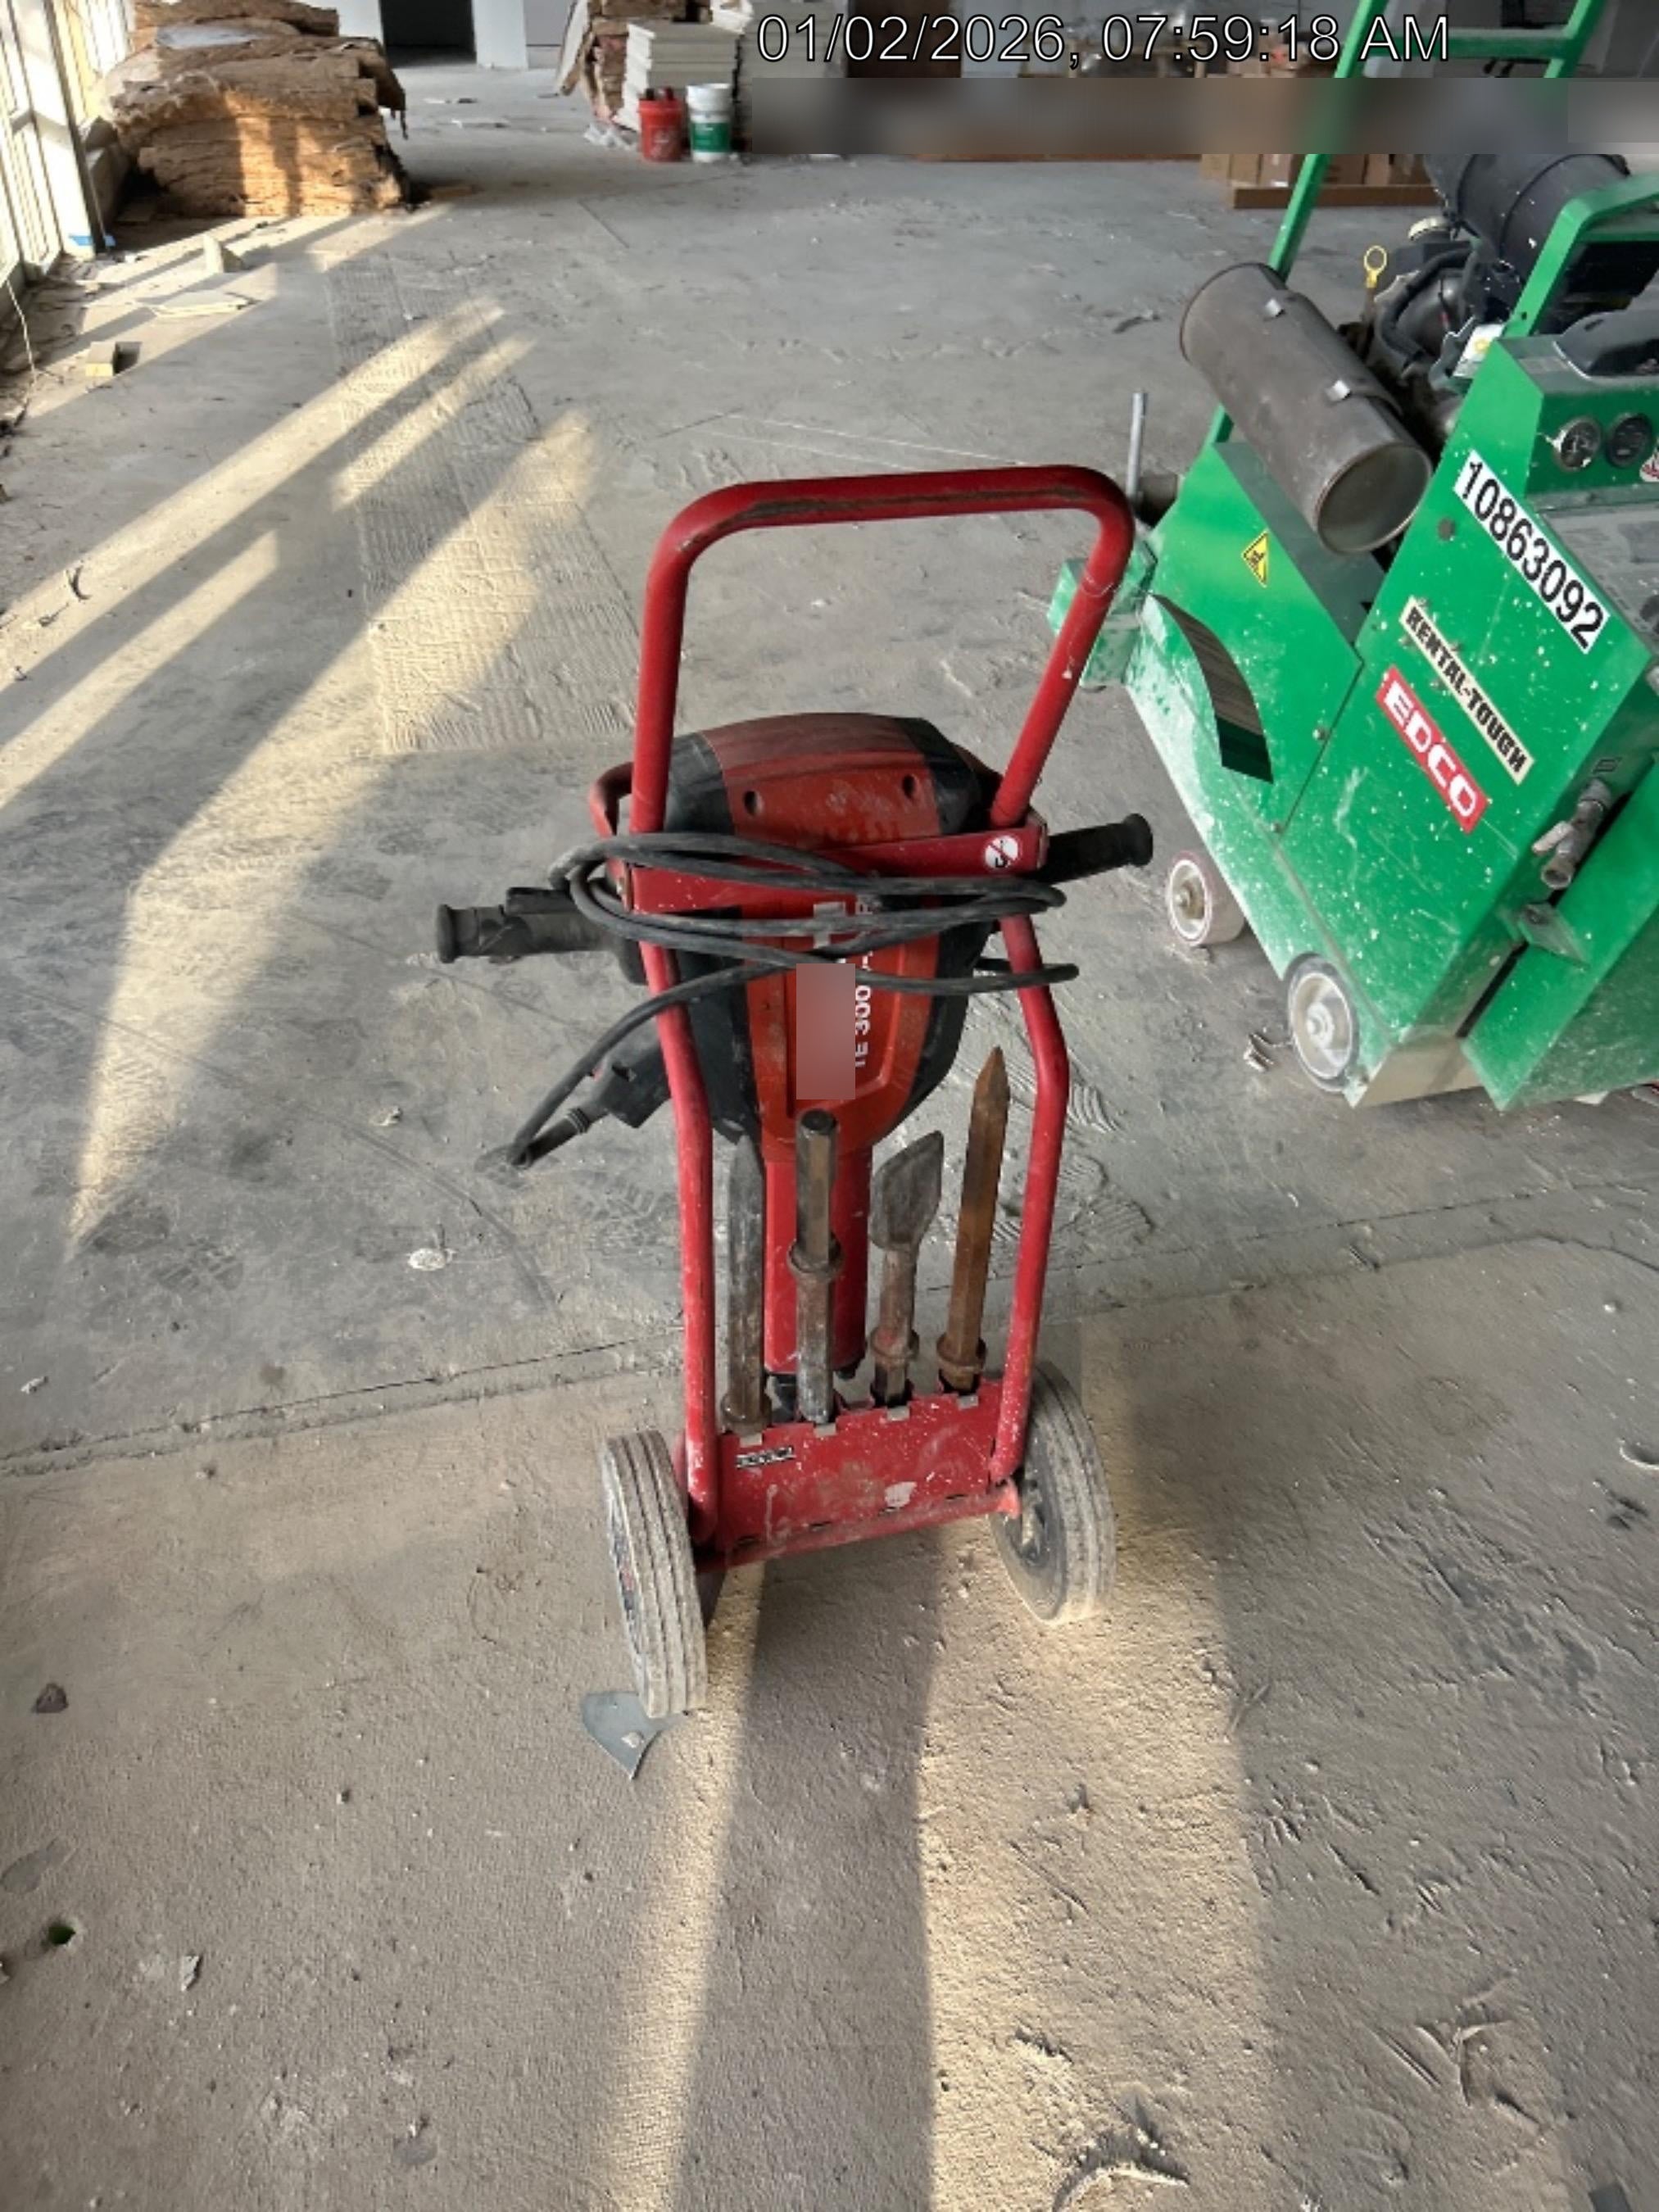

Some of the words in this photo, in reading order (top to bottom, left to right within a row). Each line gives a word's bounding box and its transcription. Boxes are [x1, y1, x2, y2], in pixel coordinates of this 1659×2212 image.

[1462, 461, 1603, 650] 10863092
[1383, 680, 1477, 817] EDCO
[1405, 606, 1527, 773] RENTAL-TOUGH
